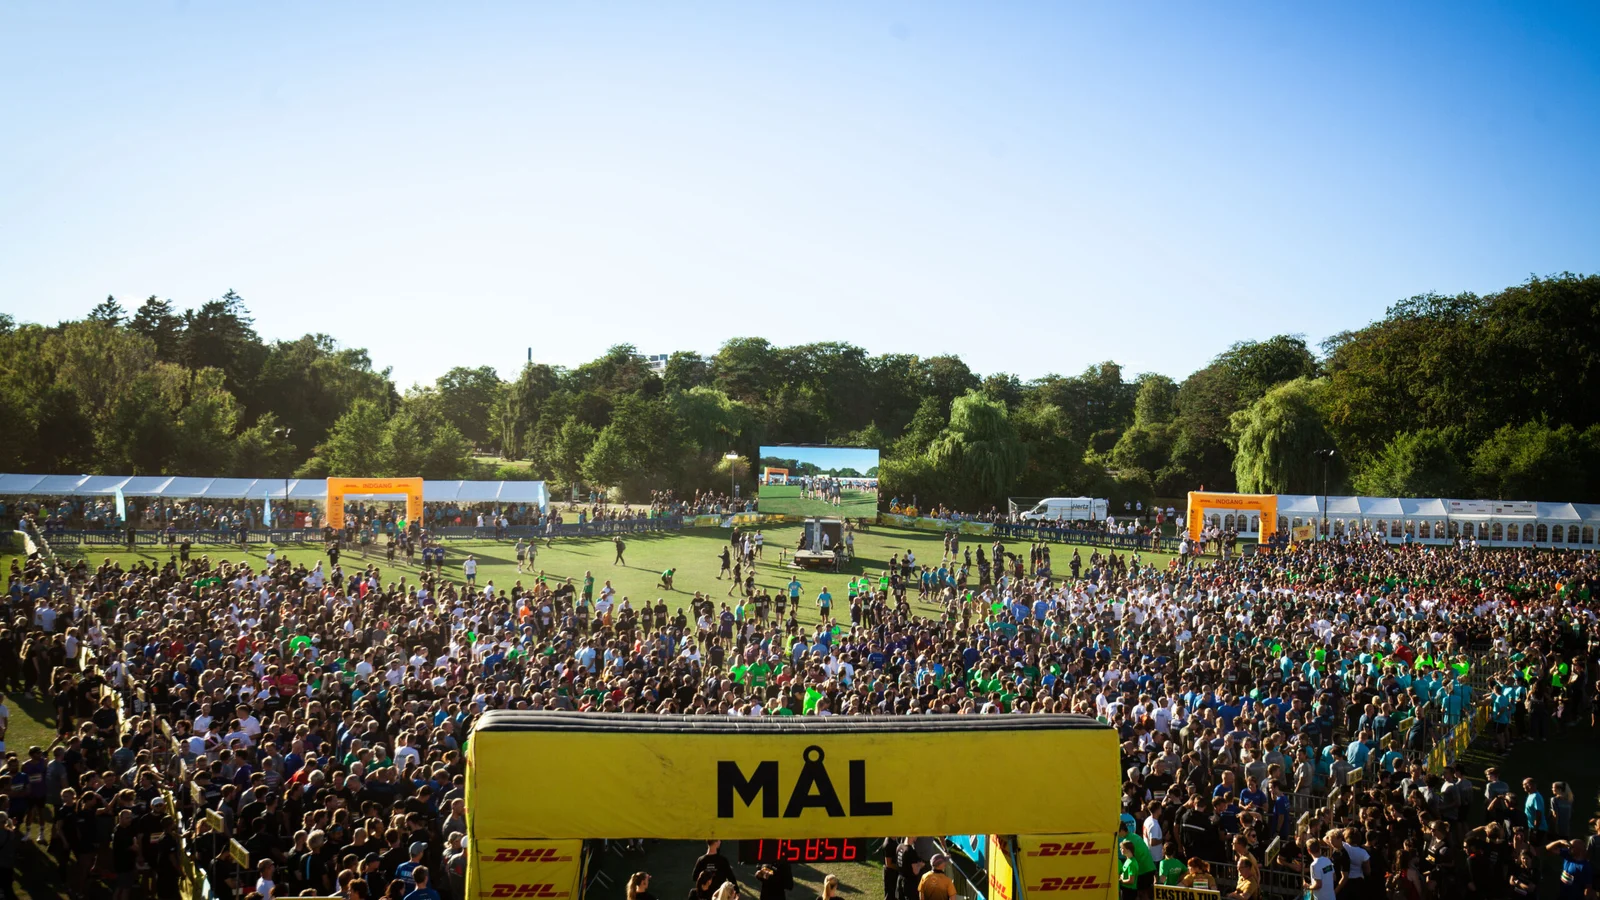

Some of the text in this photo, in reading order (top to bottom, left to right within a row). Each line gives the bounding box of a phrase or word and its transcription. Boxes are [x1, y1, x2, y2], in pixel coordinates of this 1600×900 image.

[717, 745, 893, 818] MÅL
[492, 848, 560, 862] DHL
[757, 838, 857, 861] 11:58:56
[1039, 842, 1099, 856] DHL
[491, 883, 558, 898] DHL
[1039, 876, 1101, 891] DHL
[1155, 888, 1196, 900] EKSTRA
